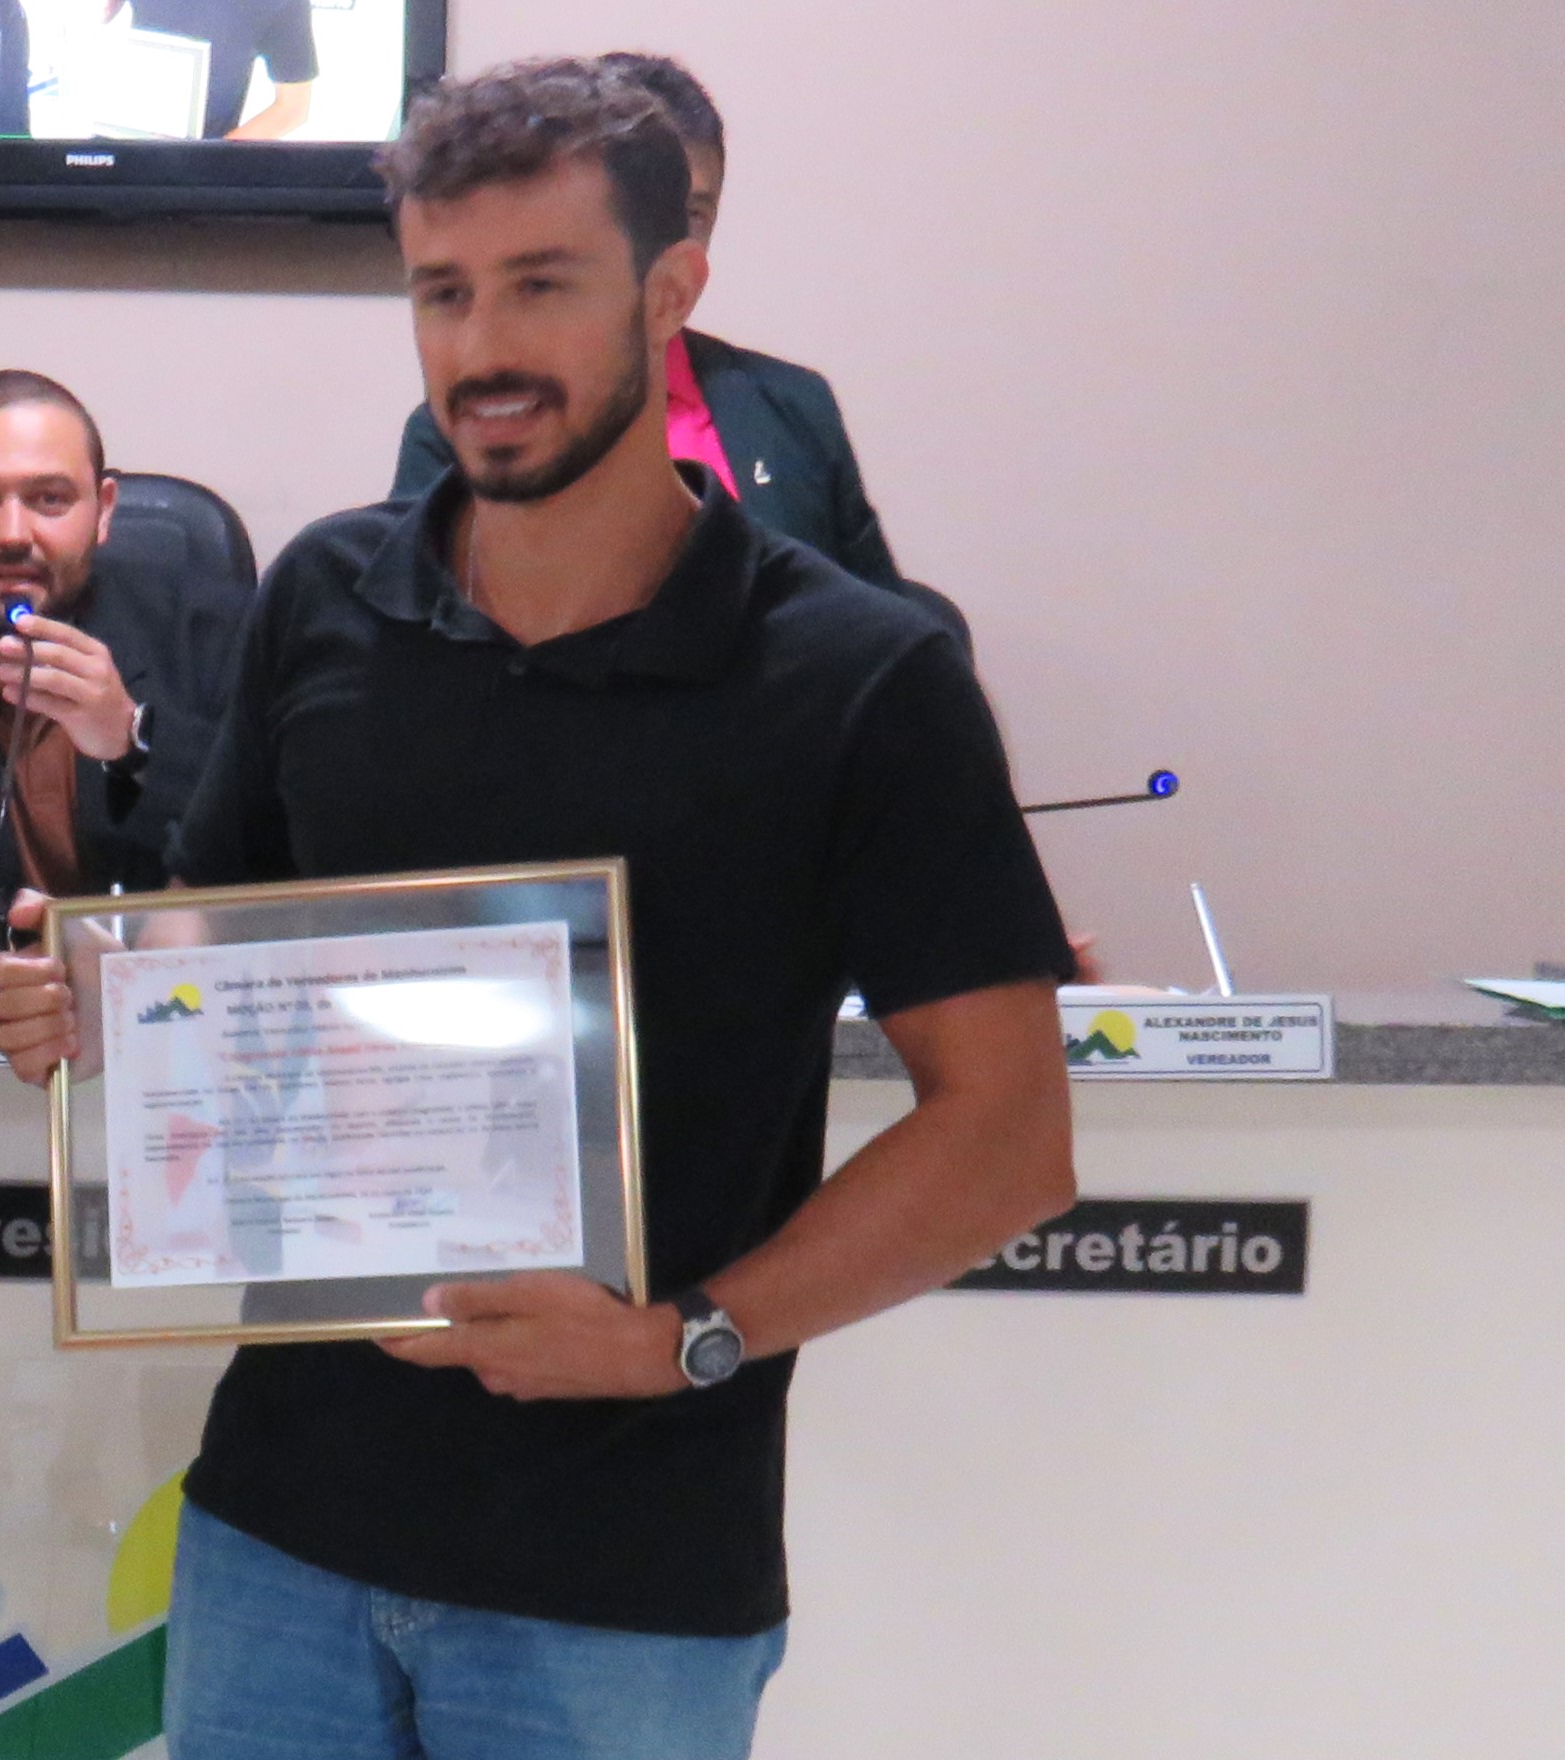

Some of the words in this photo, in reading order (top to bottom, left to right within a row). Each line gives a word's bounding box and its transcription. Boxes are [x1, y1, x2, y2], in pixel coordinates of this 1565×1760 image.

[65, 153, 114, 166] PHILIPS
[1143, 1015, 1237, 1029] ALEXANDRE
[1242, 1015, 1262, 1028] DE
[1266, 1014, 1318, 1027] JESUS
[1178, 1030, 1283, 1043] NASCIMENTO
[1186, 1053, 1272, 1065] VEREADOR
[975, 1220, 1283, 1274] cretário
